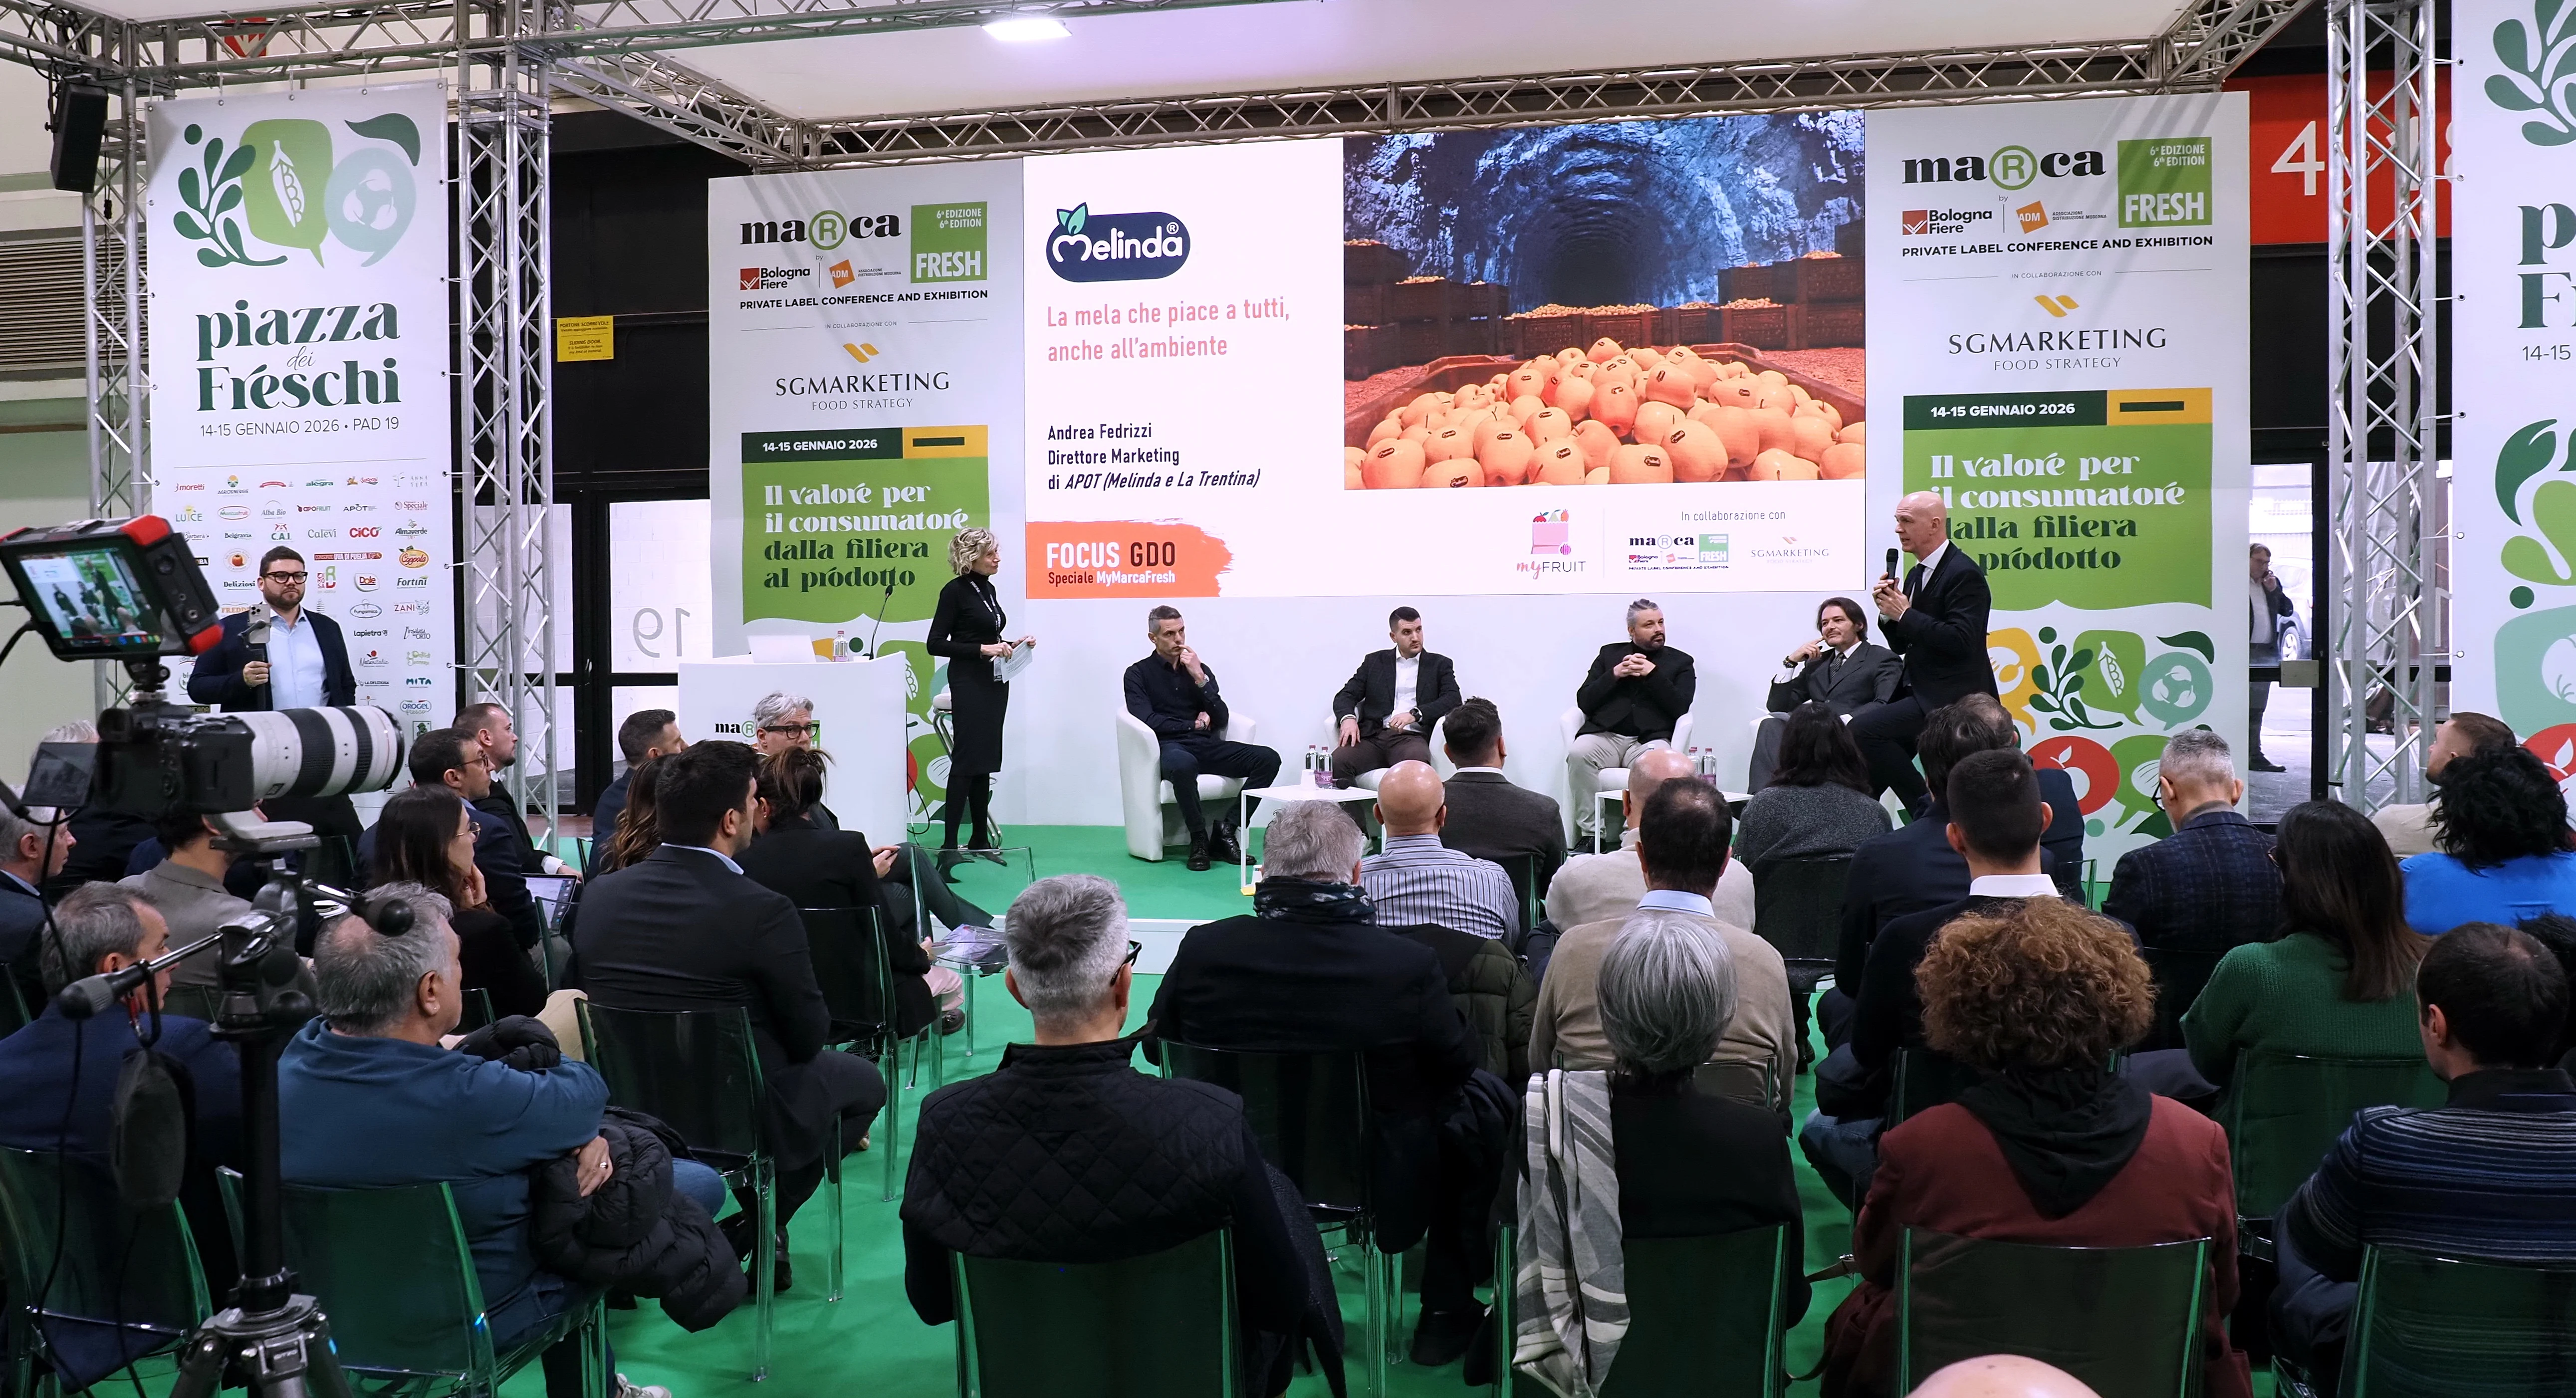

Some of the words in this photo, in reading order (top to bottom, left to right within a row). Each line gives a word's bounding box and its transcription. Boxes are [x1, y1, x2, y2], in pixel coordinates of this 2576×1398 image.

[2161, 145, 2205, 155] EDIZIONE
[2271, 121, 2325, 196] 4
[2167, 156, 2205, 165] EDITION
[945, 208, 982, 218] EDIZIONE
[1929, 209, 1992, 222] Bologna
[2124, 192, 2205, 223] FRESH
[949, 218, 981, 228] EDITION
[2019, 213, 2040, 222] ADM
[1929, 223, 1964, 234] Fiere
[1902, 246, 1957, 257] PRIVATE
[1961, 243, 2004, 254] LABEL
[2007, 240, 2098, 252] CONFERENCE
[2102, 238, 2131, 248] AND
[2135, 236, 2213, 247] EXHIBITION
[761, 267, 810, 279] Bologna
[916, 250, 980, 278] FRESH
[761, 279, 788, 289] Fiere
[740, 300, 782, 309] PRIVATE
[785, 298, 818, 307] LABEL
[821, 294, 894, 305] CONFERENCE
[897, 293, 921, 302] AND
[924, 290, 988, 301] EXHIBITION
[1048, 306, 1067, 326] La
[1075, 303, 1121, 325] mela
[1128, 302, 1161, 324] che
[1169, 300, 1219, 327] piace
[1226, 304, 1236, 320] a
[1244, 296, 1290, 321] tutti,
[196, 299, 400, 361] piazza
[1048, 339, 1103, 361] anche
[1949, 328, 2167, 354] SGMARKETING
[287, 346, 316, 370] dei
[2522, 344, 2572, 361] 14-15
[1994, 360, 2039, 371] FOOD
[2046, 357, 2121, 370] STRATEGY
[776, 372, 949, 396] SGMARKETING
[812, 400, 847, 411] FOOD
[853, 398, 913, 409] STRATEGY
[1930, 406, 1966, 417] 14-15
[1970, 405, 2036, 417] GENNAIO
[2039, 403, 2076, 414] 2026
[200, 424, 231, 437] 14-15
[235, 421, 299, 435] GENNAIO
[304, 420, 339, 433] 2026
[353, 418, 381, 430] PAD
[385, 417, 399, 429] 19
[1048, 425, 1094, 440] Andrea
[1100, 423, 1152, 438] Fedrizzi
[763, 442, 791, 452] 14-15
[793, 440, 846, 451] GENNAIO
[849, 439, 878, 449] 2026
[1048, 450, 1107, 465] Direttore
[1112, 448, 1179, 466] Marketing
[1931, 455, 1954, 478] Il
[2079, 455, 2140, 481] per
[1048, 474, 1060, 489] di
[1065, 473, 1102, 489] APOT
[1103, 472, 1161, 491] (Melinda
[1165, 476, 1173, 487] e
[1177, 472, 1193, 487] La
[1199, 468, 1261, 487] Trentina)
[764, 485, 784, 505] Il
[883, 485, 931, 508] per
[765, 512, 783, 533] il
[1681, 511, 1690, 521] In
[1694, 510, 1765, 521] collaborazione
[1769, 511, 1786, 520] con
[2034, 515, 2138, 539] filiera
[764, 540, 834, 560] dalla
[846, 538, 930, 559] filiera
[1047, 542, 1120, 569] FOCUS
[1130, 541, 1175, 567] GDO
[1700, 551, 1727, 561] FRESH
[1751, 549, 1829, 557] SGMARKETING
[764, 567, 789, 588] al
[1048, 572, 1094, 587] Speciale
[1097, 570, 1175, 587] MyMarcaFresh
